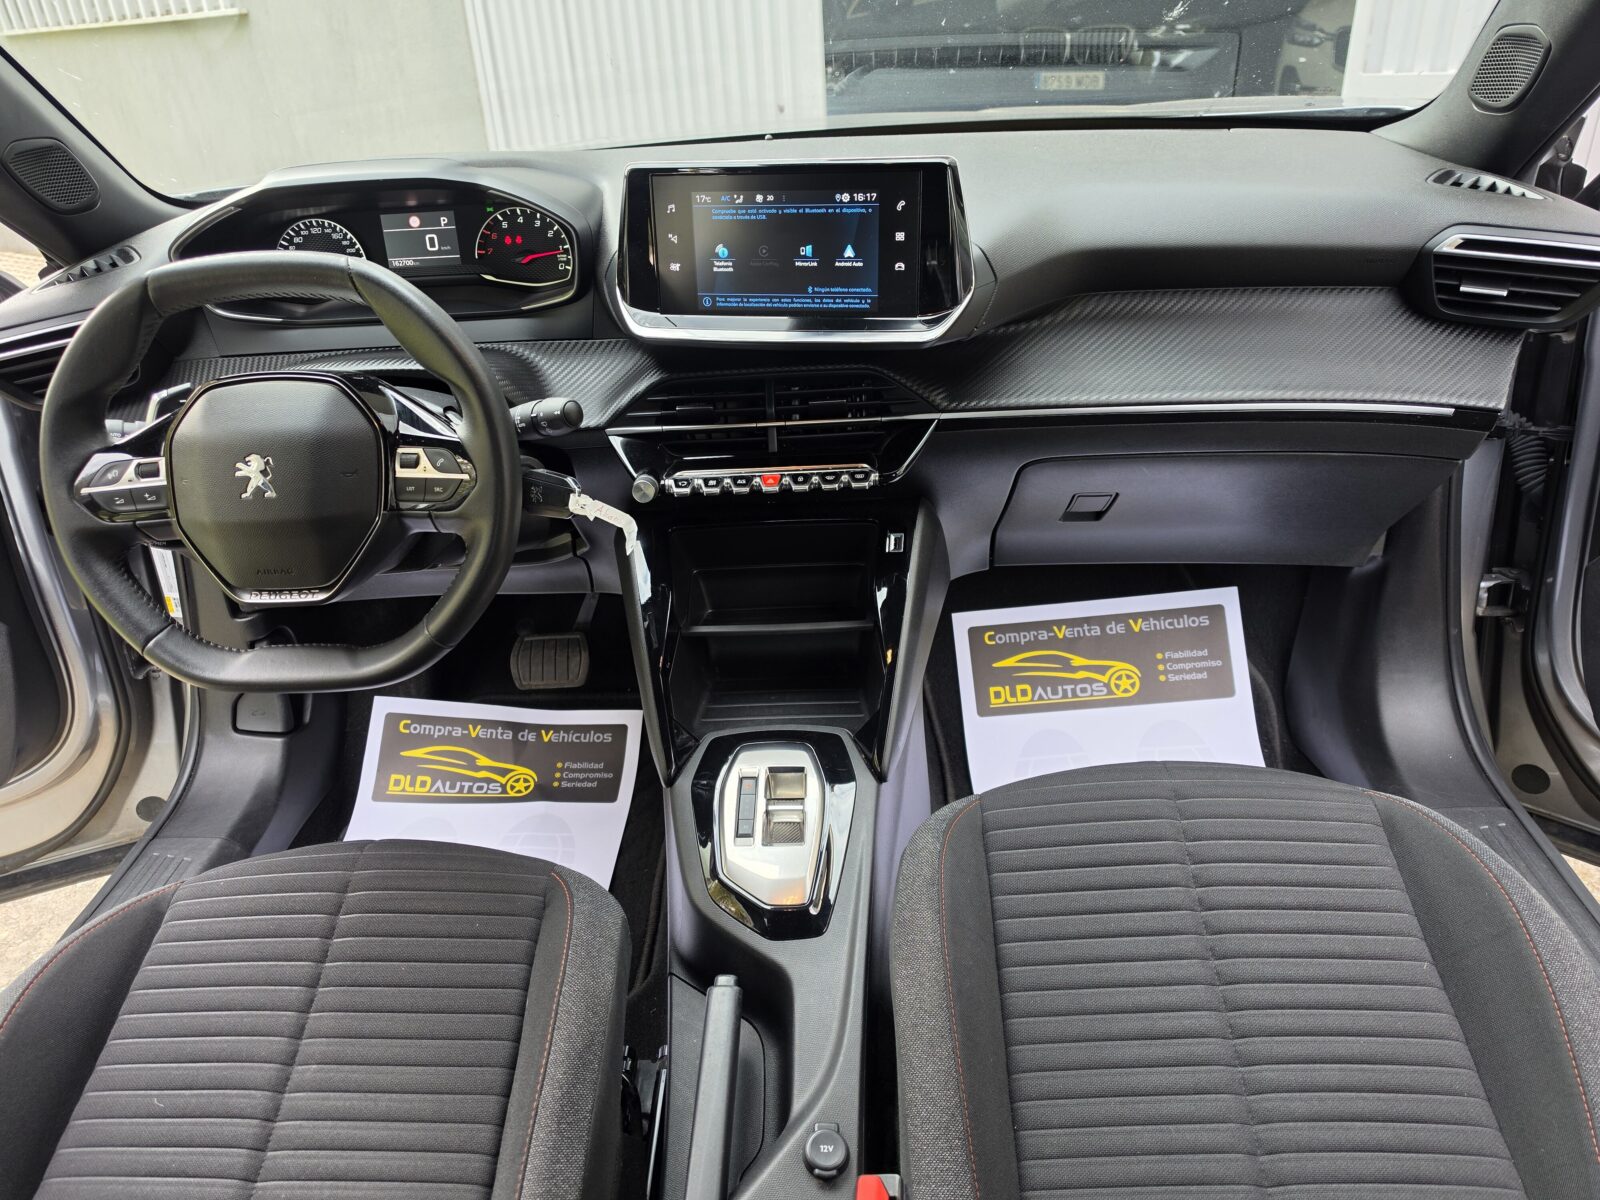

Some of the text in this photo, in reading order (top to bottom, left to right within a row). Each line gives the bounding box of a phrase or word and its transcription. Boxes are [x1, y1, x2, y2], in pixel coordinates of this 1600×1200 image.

[853, 193, 877, 201] 16:17
[440, 216, 448, 227] P
[425, 234, 439, 251] 0
[250, 590, 319, 600] PEUGEOT
[984, 614, 1210, 645] Compra-Venta de Vehículos
[1165, 649, 1208, 660] Fiabilidad
[1166, 659, 1222, 671] Compromiso
[1168, 671, 1208, 682] Seriedad
[399, 719, 613, 743] Compra-Venta de Vehículos
[564, 761, 604, 769] Fiabilidad
[562, 771, 614, 780] Compromiso
[561, 780, 598, 788] Seriedad
